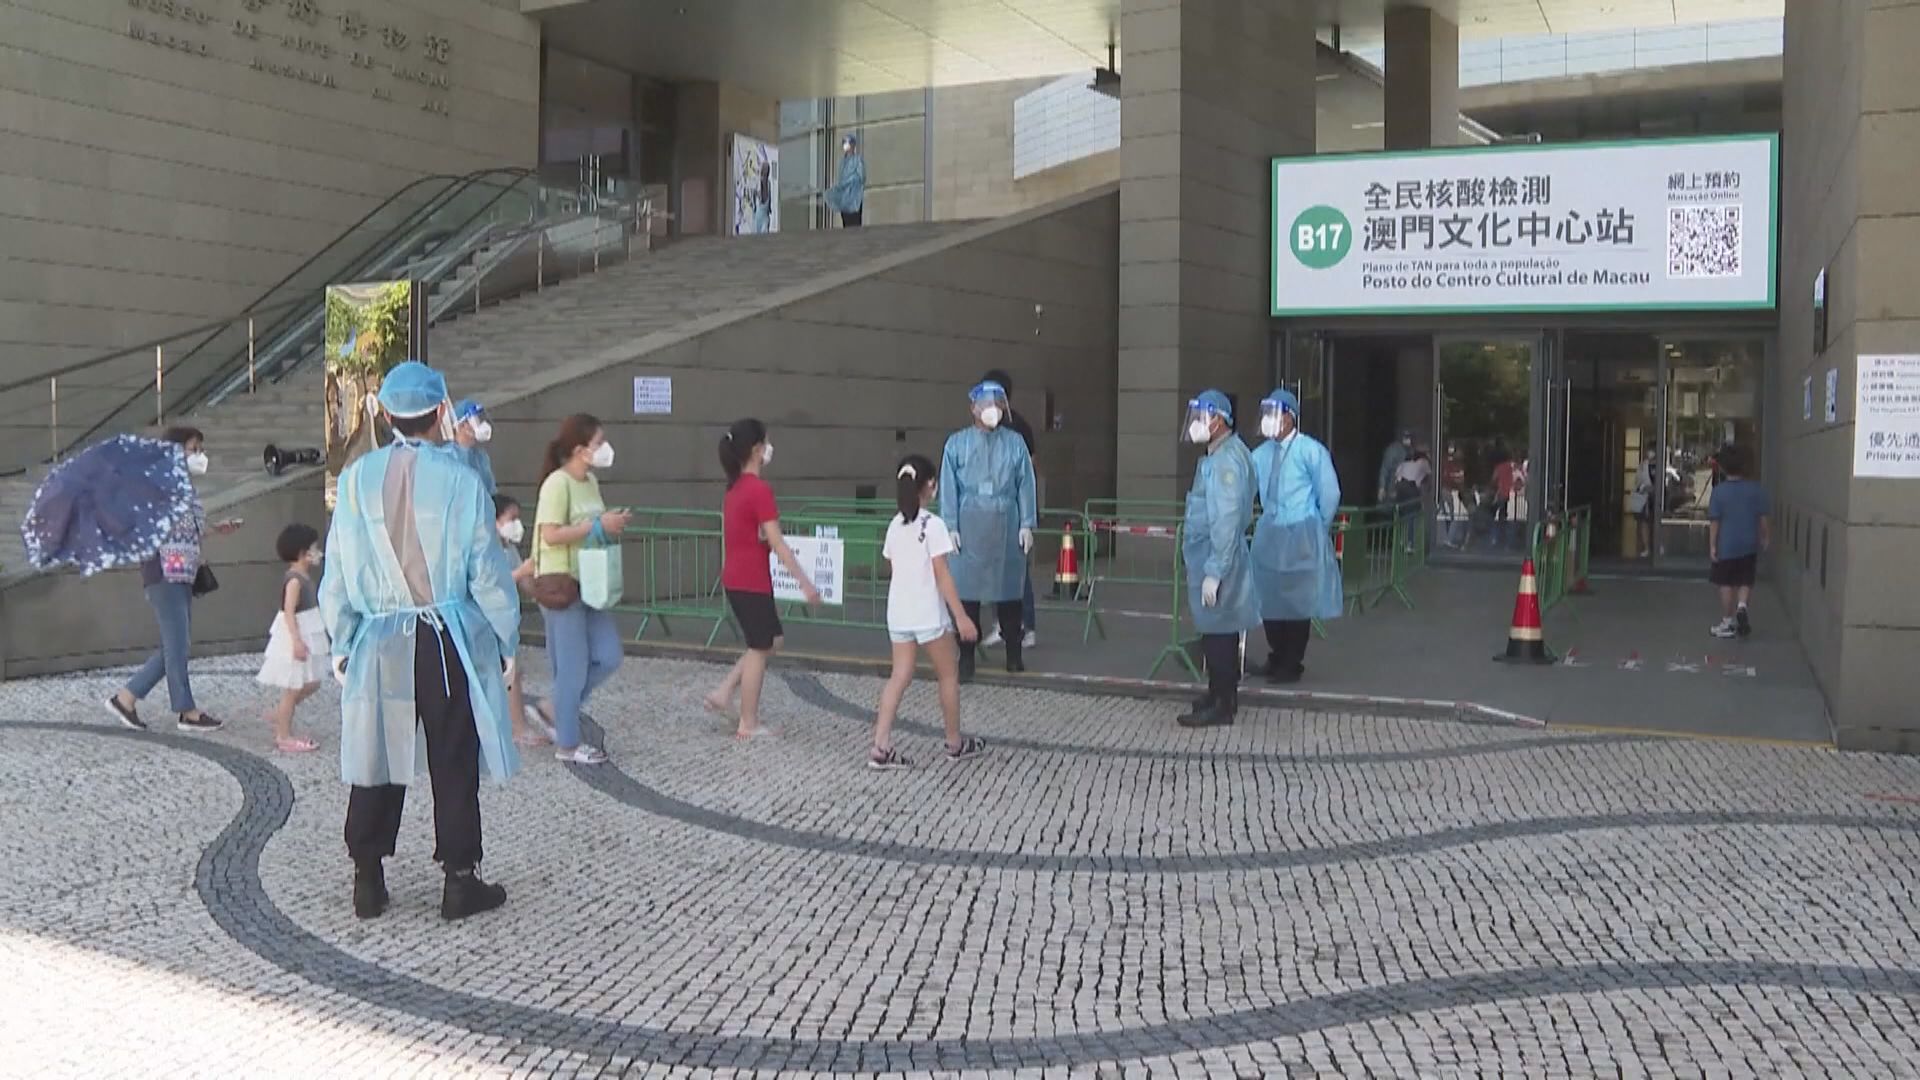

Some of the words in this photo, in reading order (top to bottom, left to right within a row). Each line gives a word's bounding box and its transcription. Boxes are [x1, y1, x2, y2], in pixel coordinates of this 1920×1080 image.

[1667, 171, 1741, 191] 網上預約
[1364, 174, 1551, 211] 全民核酸檢測
[1711, 189, 1740, 200] Online
[1298, 223, 1344, 251] B17
[1363, 207, 1635, 251] 澳門文化中心站
[1362, 261, 1393, 273] Plano
[1396, 261, 1409, 272] de
[1411, 260, 1433, 271] TAN
[1436, 261, 1460, 272] para
[1463, 259, 1488, 271] toda
[1491, 260, 1498, 269] a
[1501, 257, 1560, 272] população
[1363, 274, 1408, 289] Posto
[1411, 273, 1433, 289] do
[1436, 272, 1492, 288] Centro
[1496, 270, 1562, 287] Cultural
[1566, 269, 1589, 285] de
[1593, 268, 1650, 285] Macau
[1866, 451, 1902, 462] Priority
